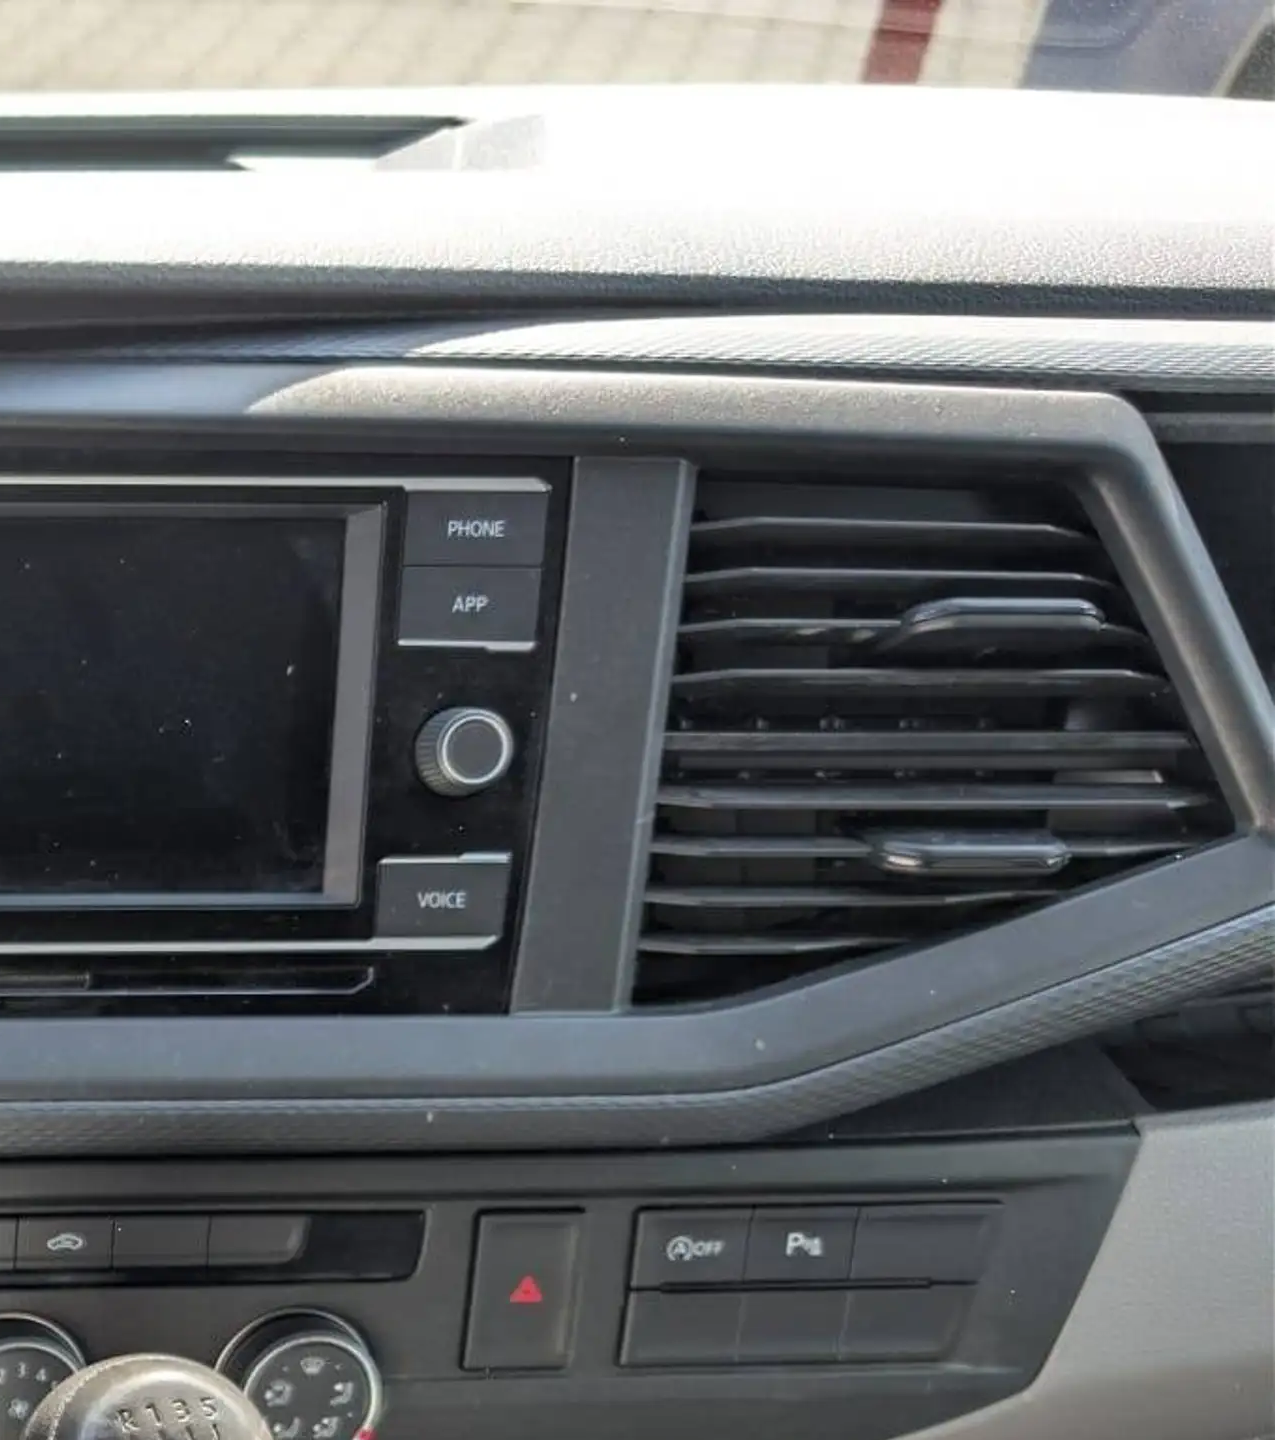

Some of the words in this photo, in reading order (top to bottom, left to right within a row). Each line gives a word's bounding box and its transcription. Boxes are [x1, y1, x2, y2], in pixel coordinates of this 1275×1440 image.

[447, 520, 506, 538] PHONE
[452, 596, 488, 613] APP
[417, 891, 467, 908] VOICE
[171, 1398, 191, 1422] 3
[199, 1396, 218, 1420] 5
